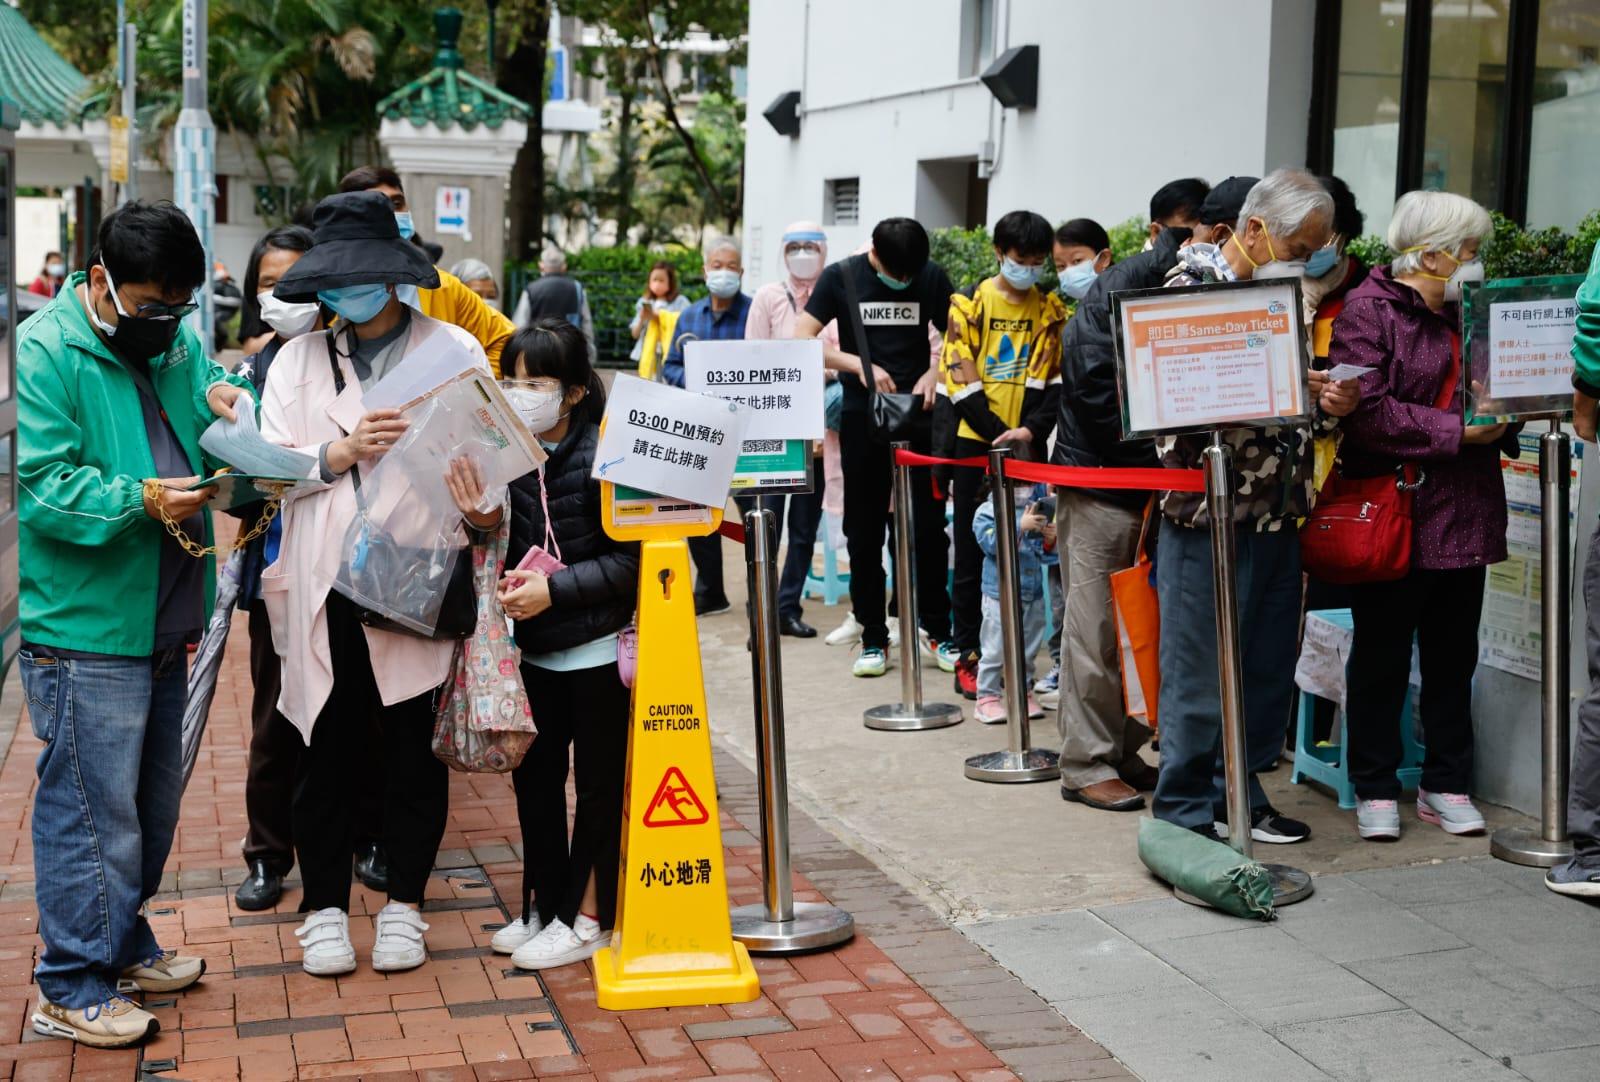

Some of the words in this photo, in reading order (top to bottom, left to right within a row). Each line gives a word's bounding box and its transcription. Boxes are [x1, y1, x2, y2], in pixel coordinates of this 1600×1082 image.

[863, 307, 892, 320] NIKE
[893, 307, 916, 320] F.C.
[1189, 321, 1247, 337] Same-Day
[1250, 317, 1284, 331] Ticket
[706, 370, 744, 383] 03:30
[716, 394, 793, 411] 在此排隊
[628, 409, 669, 431] 03:00
[631, 438, 709, 472] 請在此排隊
[649, 703, 693, 717] CAUTION
[643, 719, 664, 732] WET
[666, 717, 700, 731] FLOOR
[639, 858, 712, 888] 小心地滑
